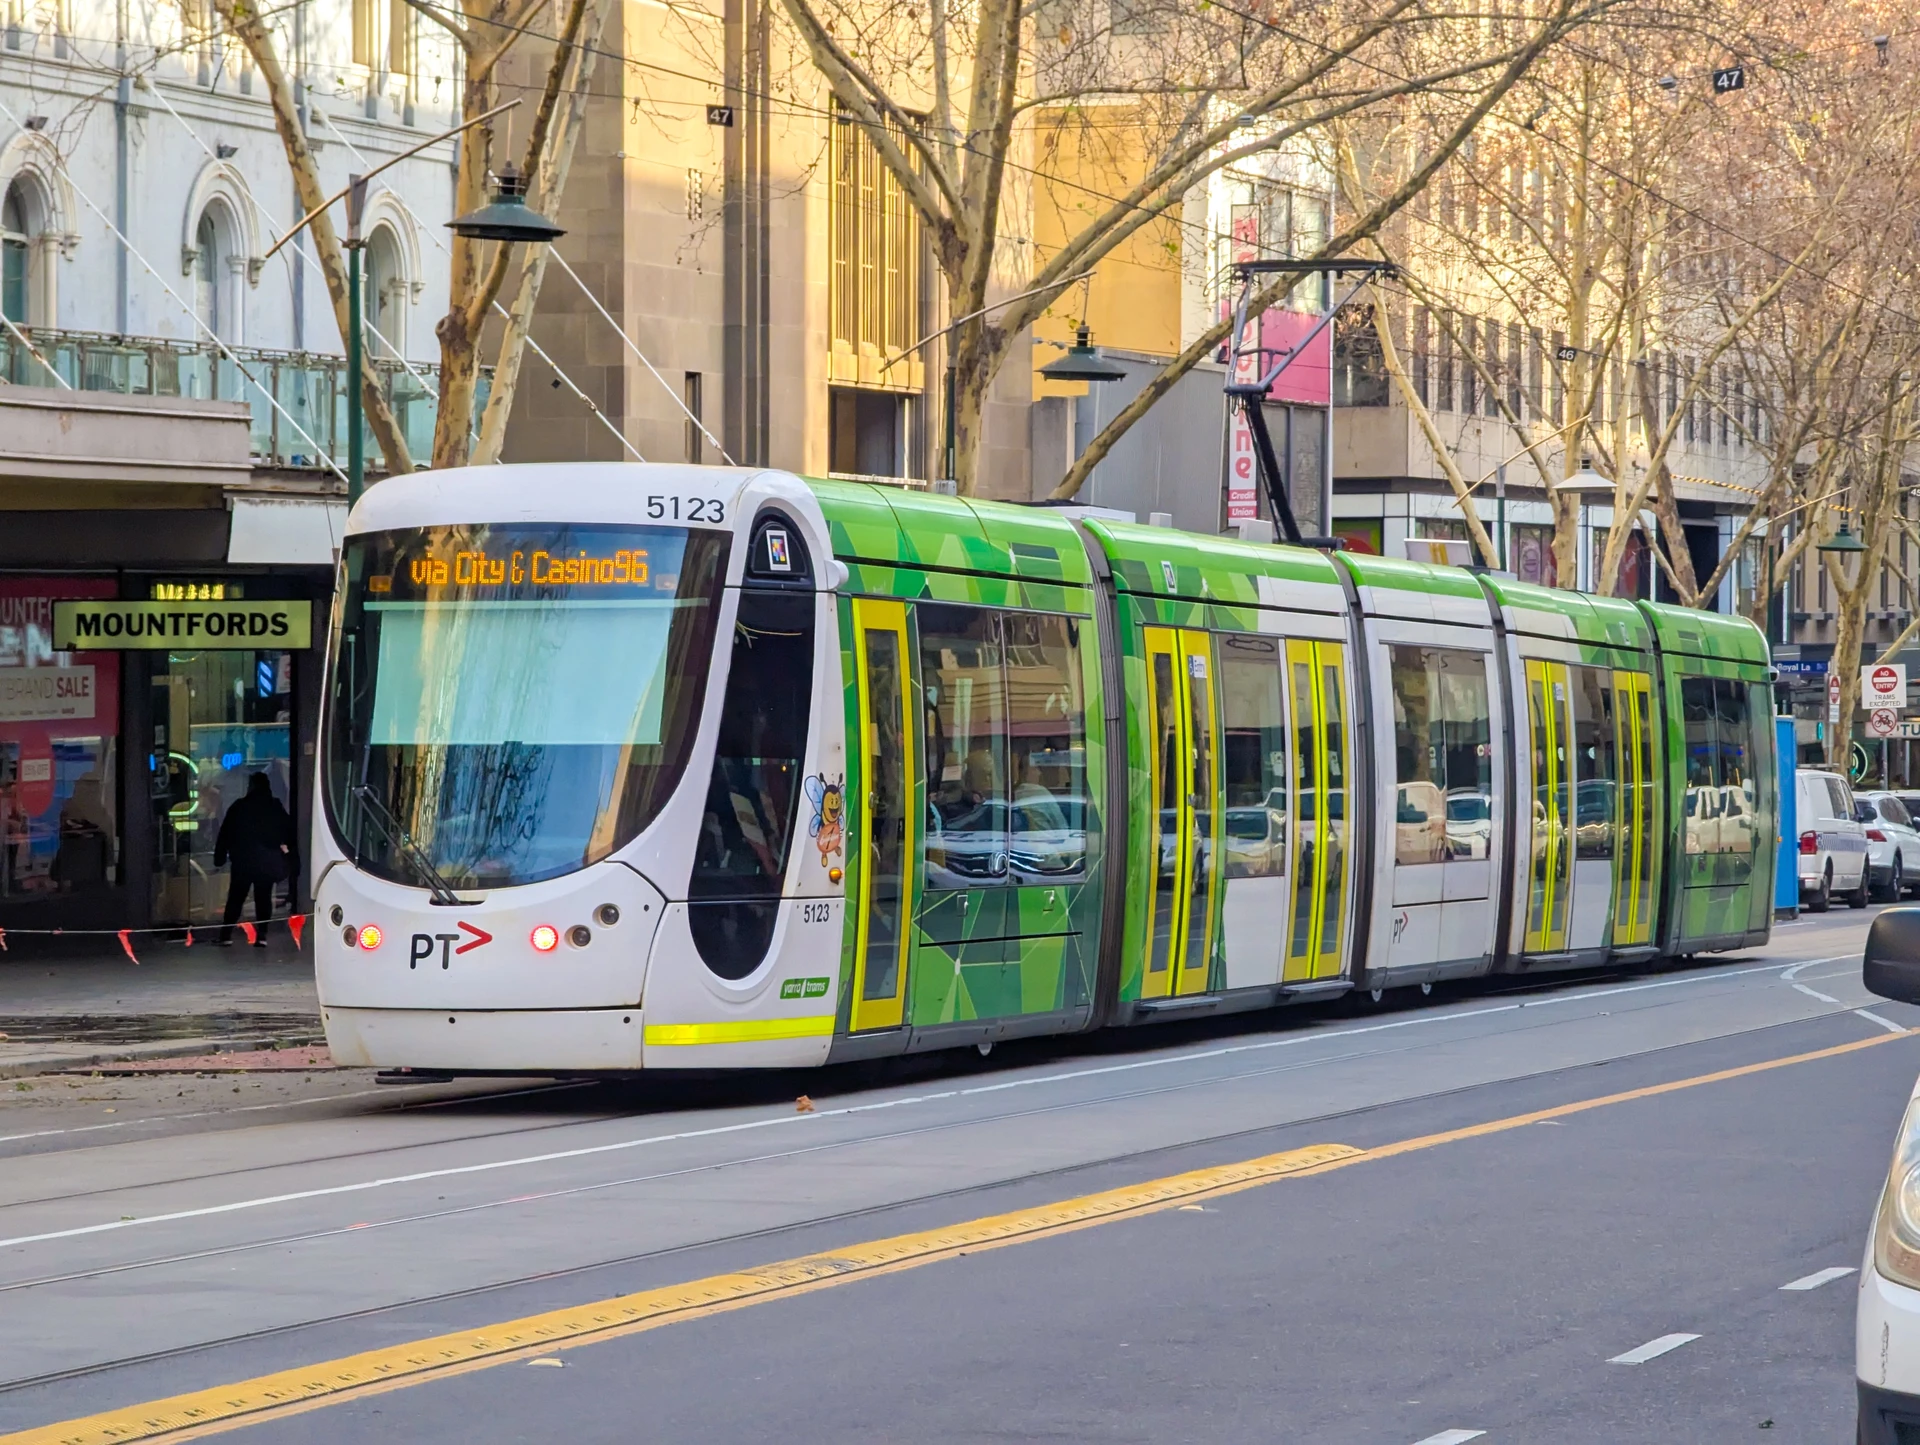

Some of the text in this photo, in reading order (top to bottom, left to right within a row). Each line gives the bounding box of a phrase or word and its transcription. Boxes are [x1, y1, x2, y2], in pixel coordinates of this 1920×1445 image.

[1718, 70, 1740, 88] 47
[710, 109, 730, 123] 47
[1559, 350, 1574, 360] 46
[1231, 491, 1255, 500] Credit
[647, 495, 725, 524] 5123
[1232, 507, 1254, 517] Union
[411, 552, 449, 584] via
[455, 552, 505, 584] City
[511, 551, 525, 584] &
[75, 613, 290, 637] MOUNTFORDS
[1777, 663, 1799, 673] Royal
[1801, 663, 1811, 671] La
[57, 676, 90, 698] SALE
[803, 904, 830, 923] 5123
[783, 981, 826, 997] yarra trams
